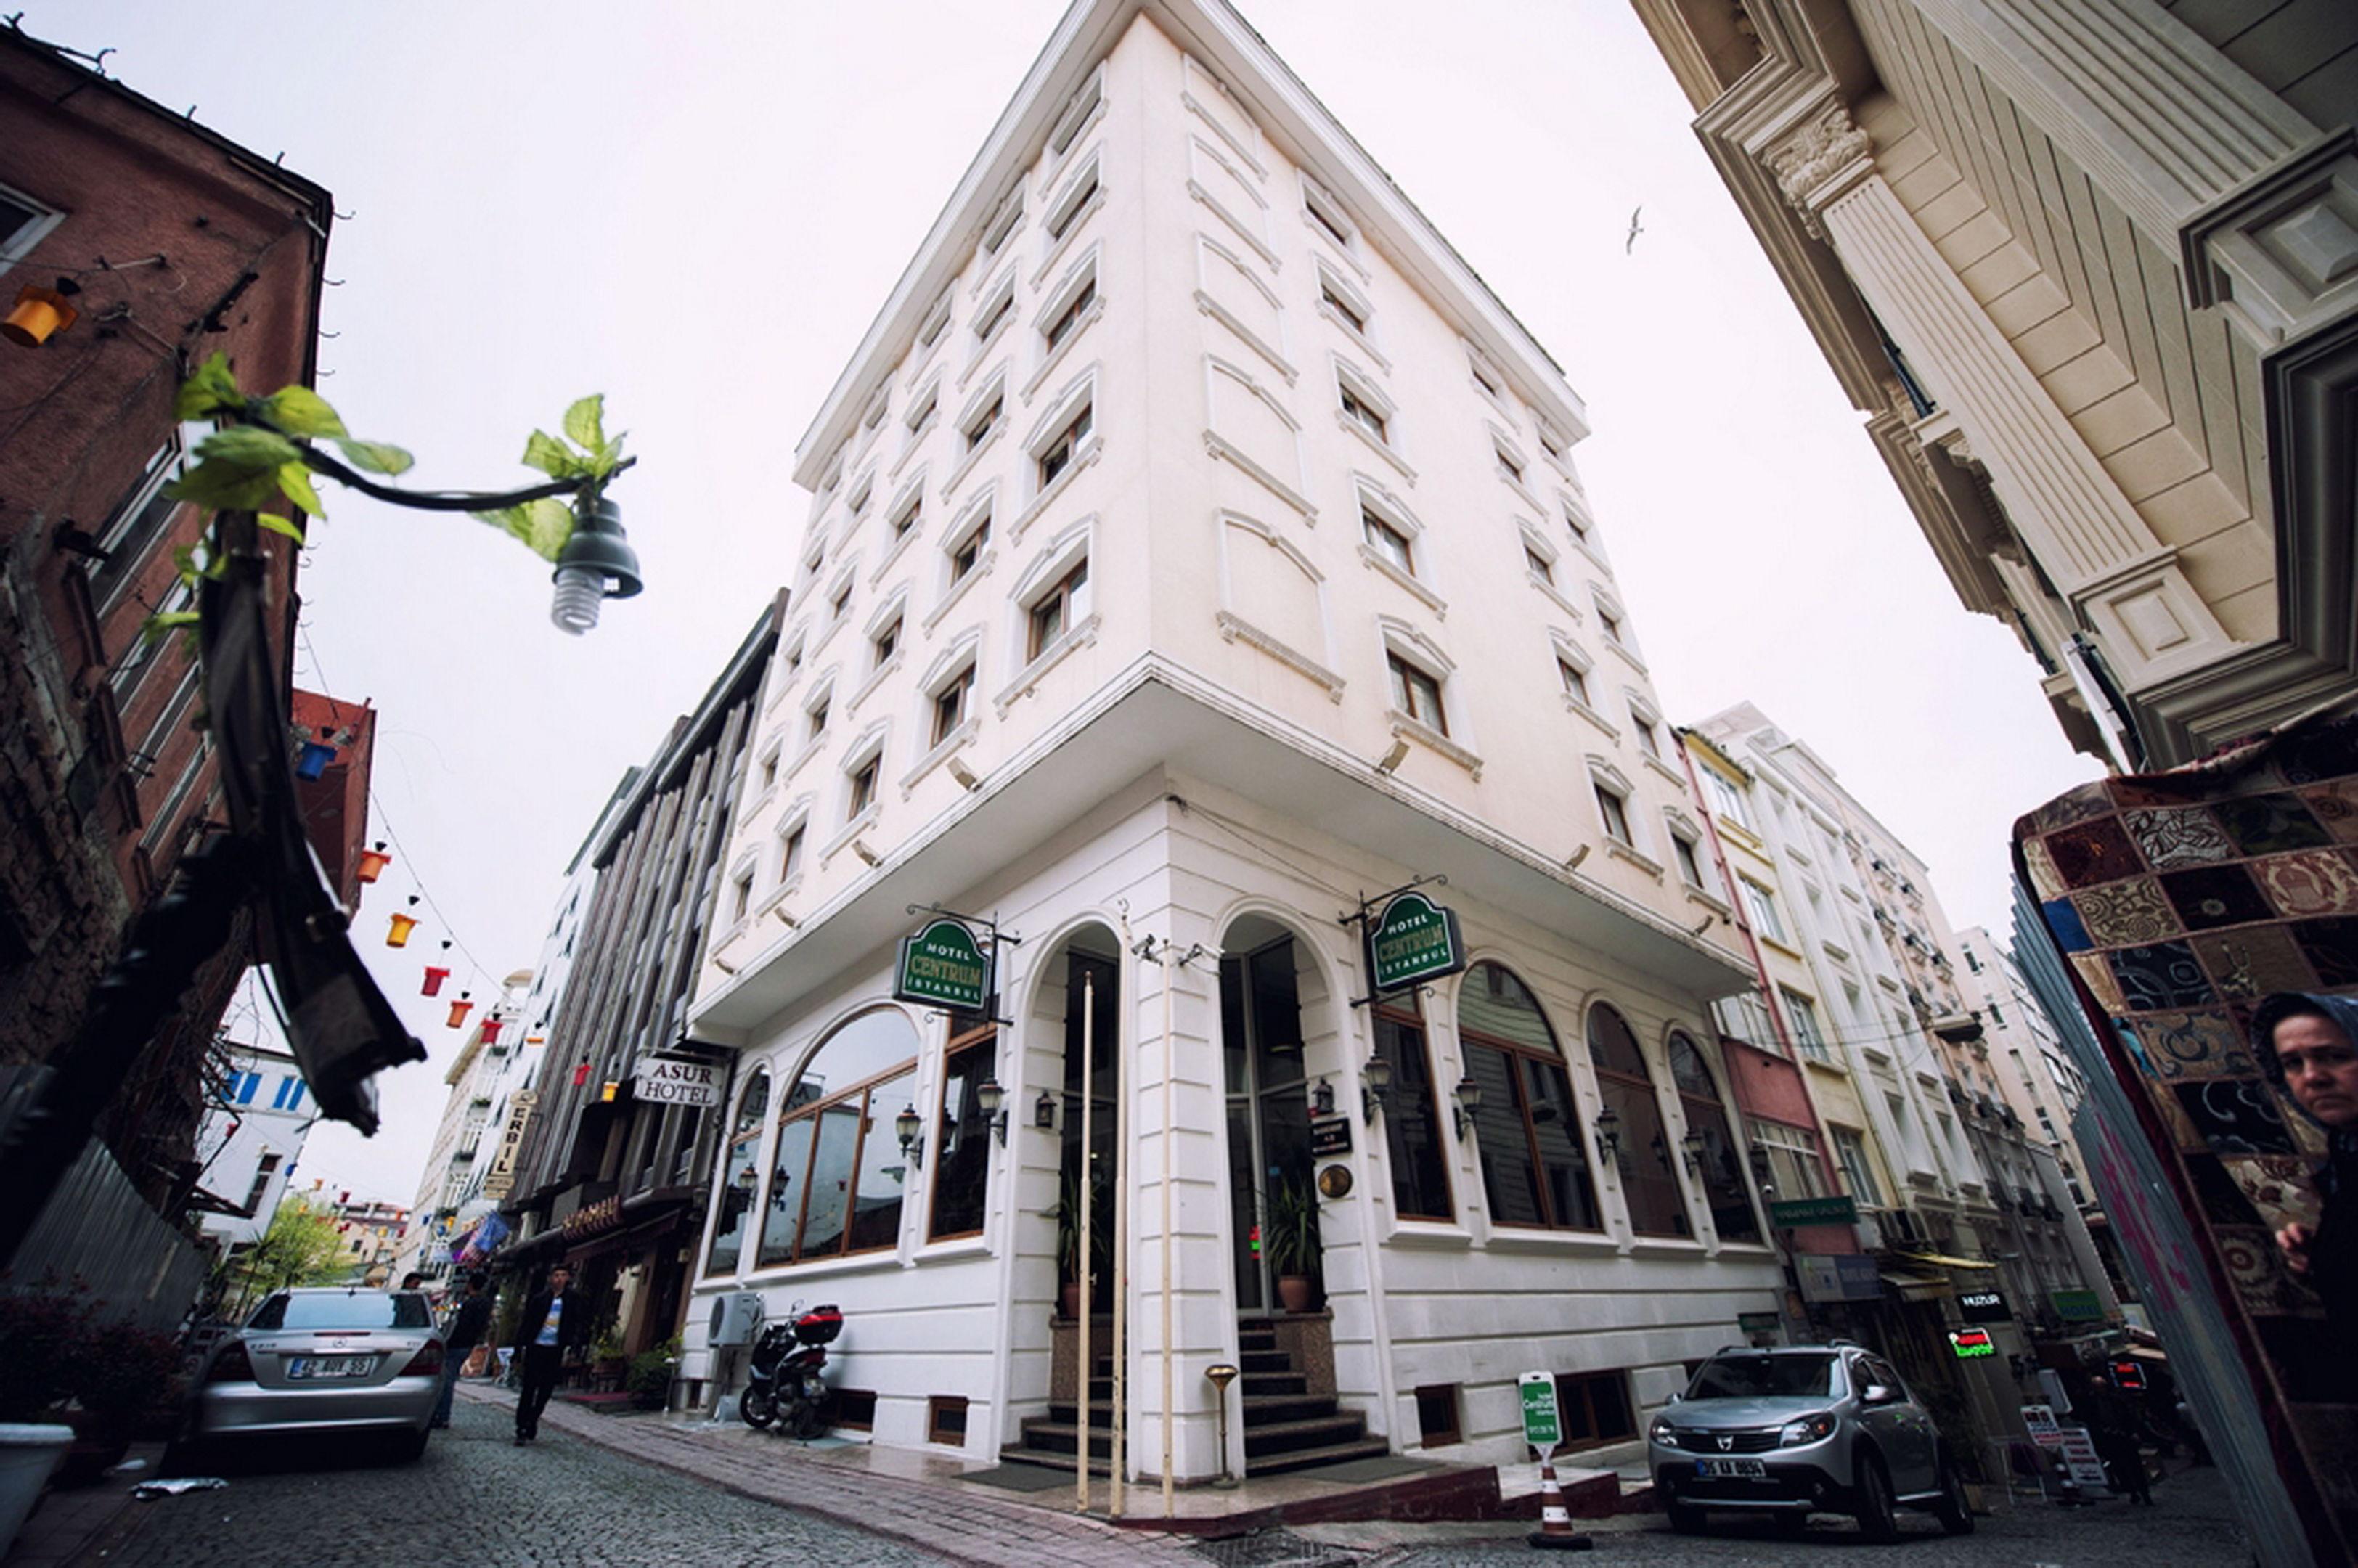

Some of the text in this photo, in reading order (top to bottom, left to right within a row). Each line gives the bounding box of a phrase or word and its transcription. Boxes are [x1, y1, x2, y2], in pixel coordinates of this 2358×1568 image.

[1387, 914, 1428, 934] HOTEL
[926, 943, 970, 960] HOTEL
[910, 955, 982, 987] CENTRUM
[653, 1063, 712, 1085] ASUR
[645, 1082, 712, 1104] HOTEL
